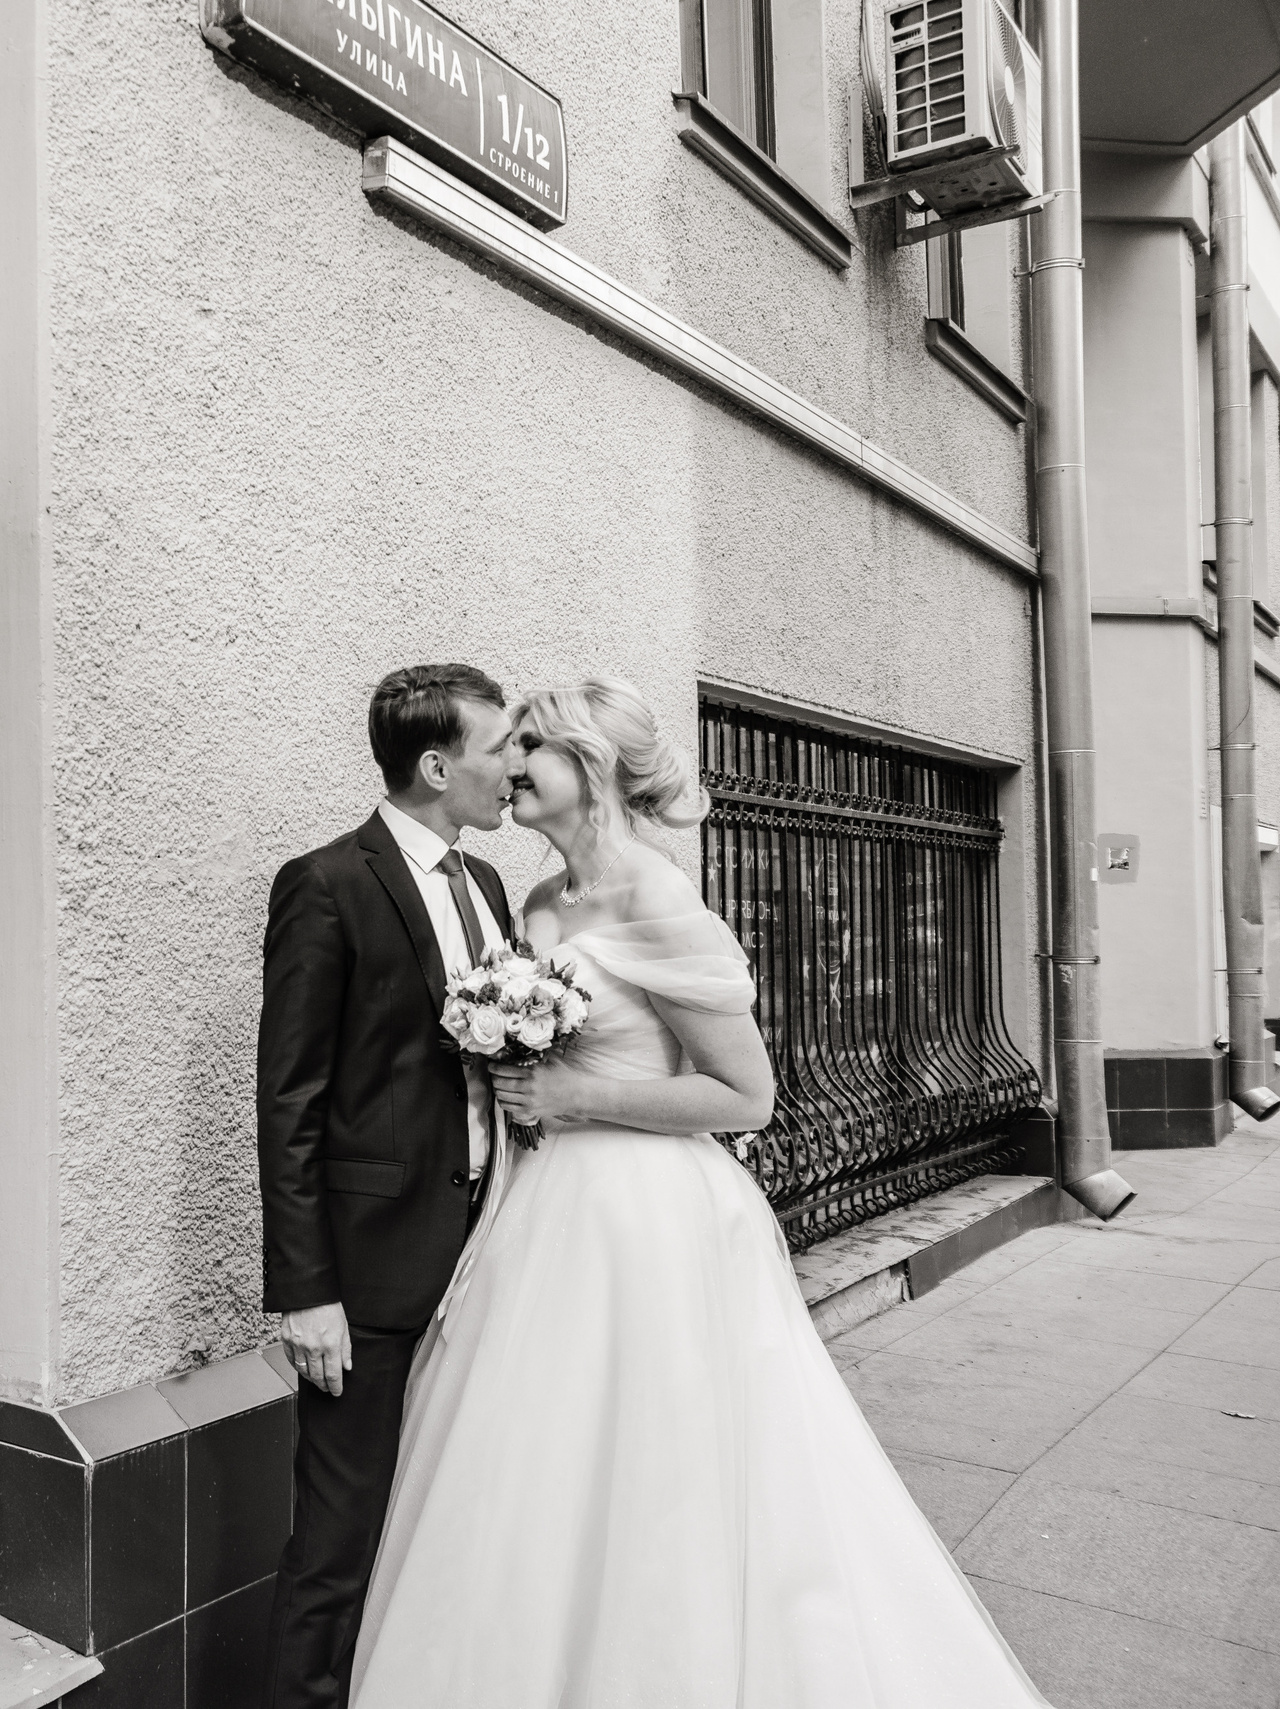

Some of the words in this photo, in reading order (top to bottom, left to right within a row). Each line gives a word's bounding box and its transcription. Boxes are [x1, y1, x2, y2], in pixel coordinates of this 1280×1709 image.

[324, 0, 469, 97] ЫГИНА
[335, 27, 408, 97] УЛИЦА
[496, 94, 551, 171] 1/12
[489, 147, 551, 200] СТРОЕНИЕ
[553, 190, 560, 204] 1
